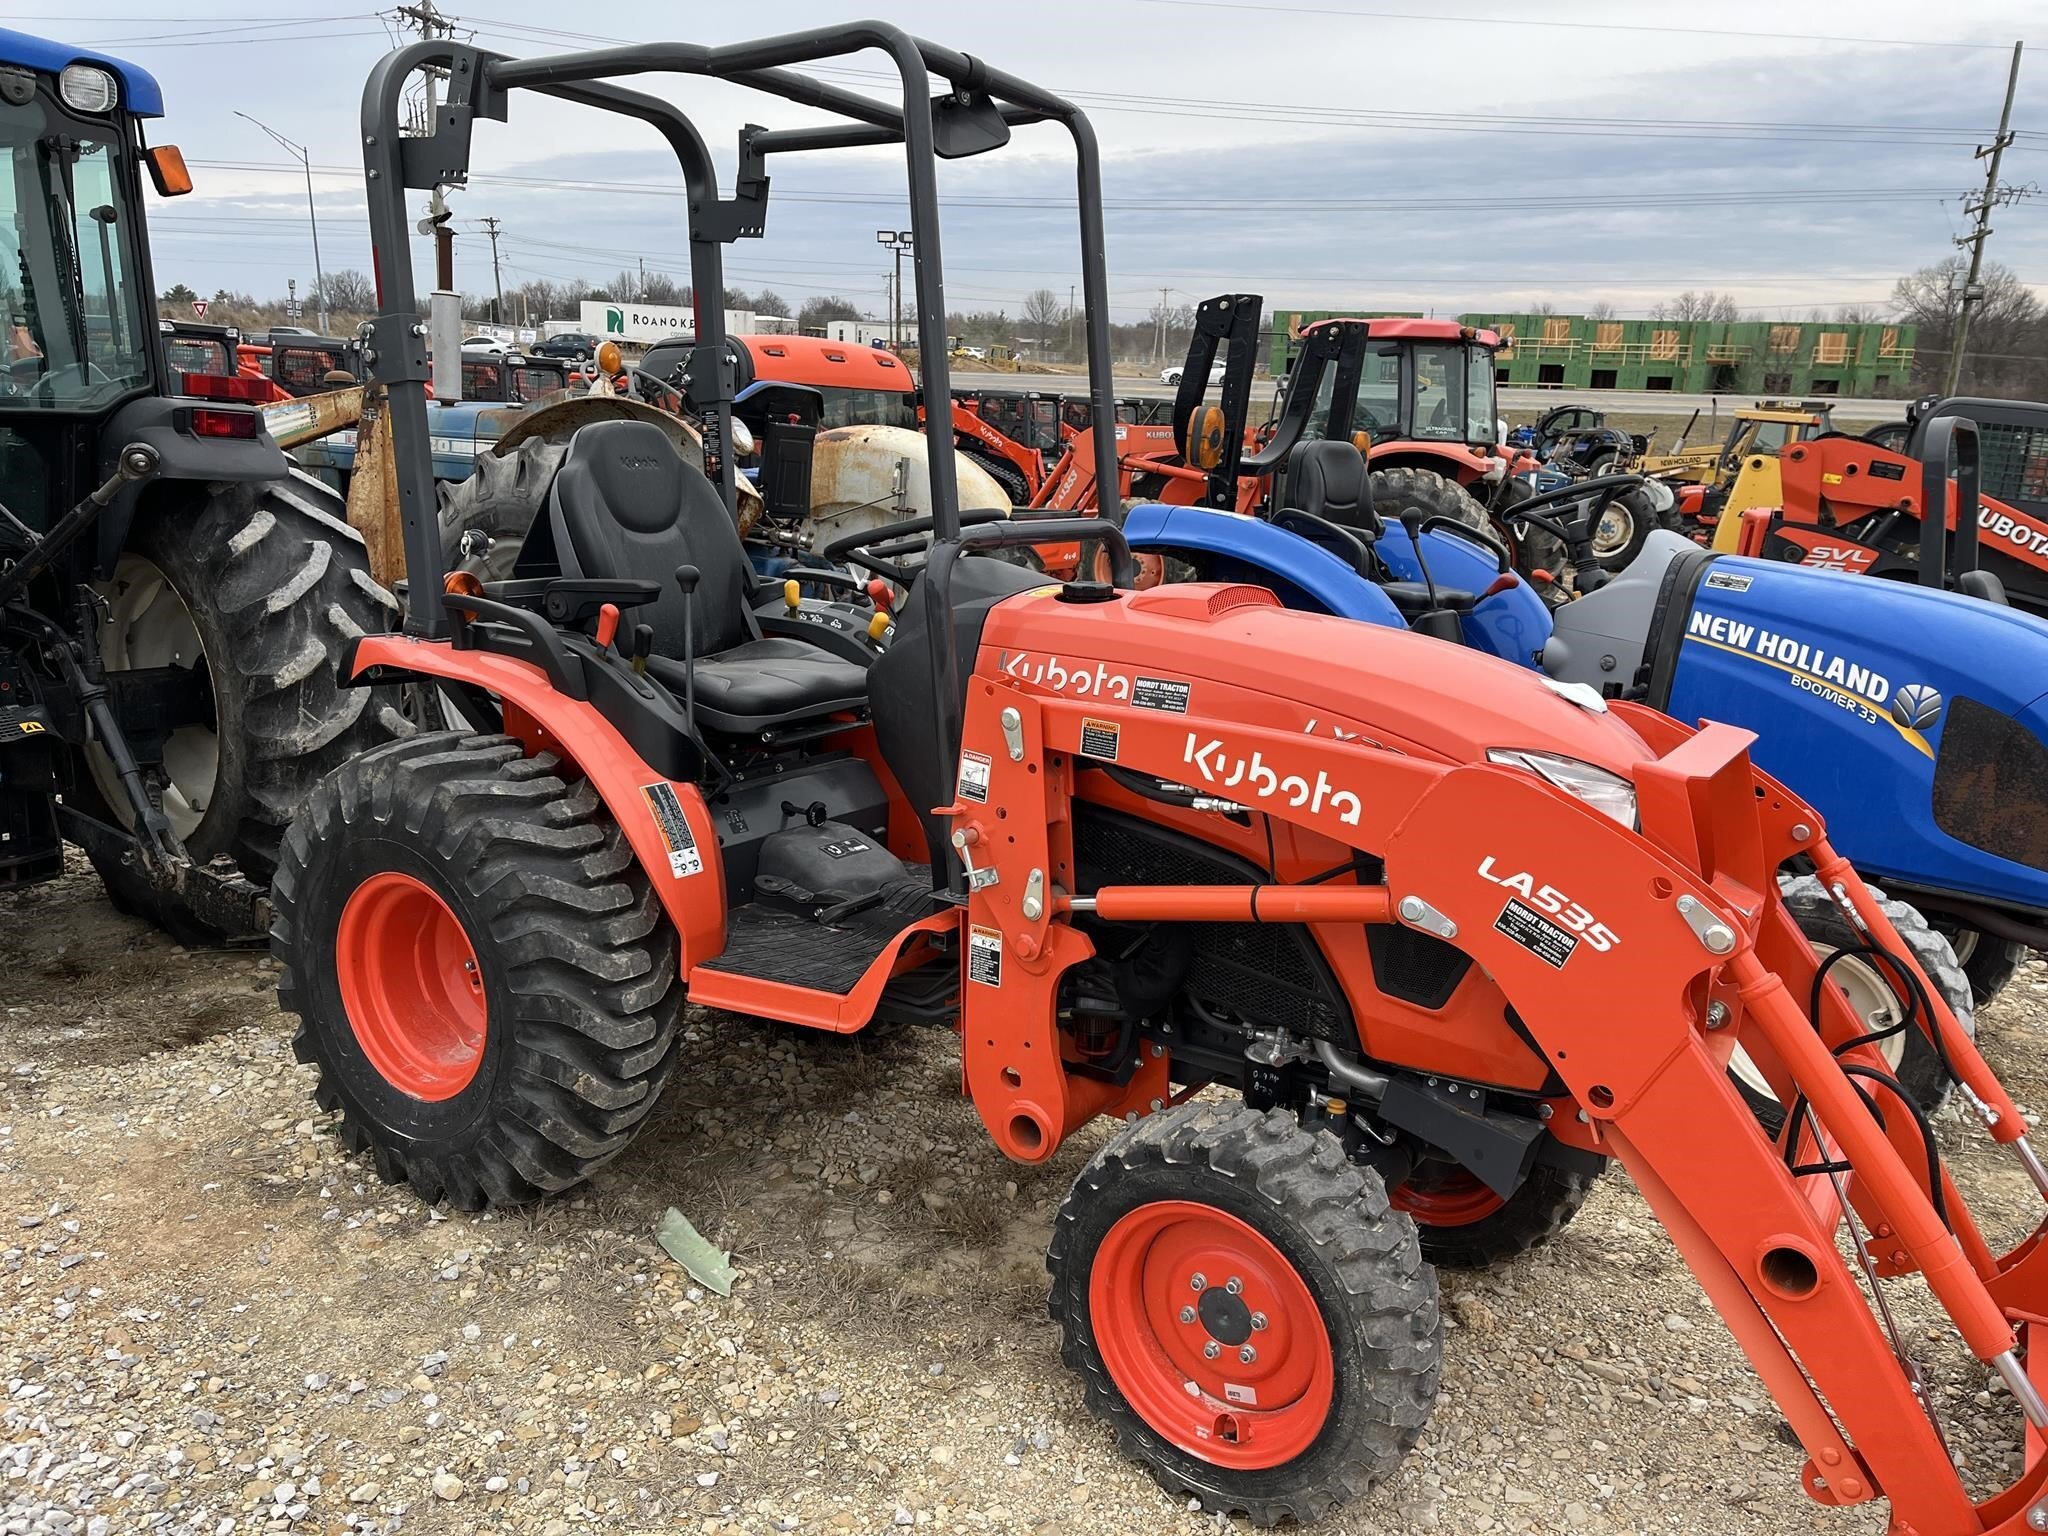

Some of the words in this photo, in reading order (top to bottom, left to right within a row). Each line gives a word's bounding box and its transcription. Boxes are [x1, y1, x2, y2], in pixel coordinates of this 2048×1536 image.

[632, 313, 696, 329] ROANOKE
[1146, 431, 1175, 439] KUBO
[1673, 456, 1702, 466] HOLLAND
[1978, 504, 2048, 560] UBOTA
[1807, 546, 1871, 563] SVL
[1689, 611, 1754, 649] NEW
[1755, 630, 1889, 703] HOLLAND
[999, 651, 1129, 700] Kubota
[1136, 680, 1155, 690] MORDT
[1160, 683, 1189, 694] TRACTOR
[1791, 673, 1856, 713] BOOMER
[1857, 706, 1878, 725] 33
[1092, 722, 1117, 732] WARNING
[968, 753, 990, 764] DANGER
[1183, 732, 1362, 826] Kubota
[1477, 855, 1621, 952] LA535
[1507, 900, 1538, 925] MORDT
[1535, 919, 1575, 949] TRACTOR
